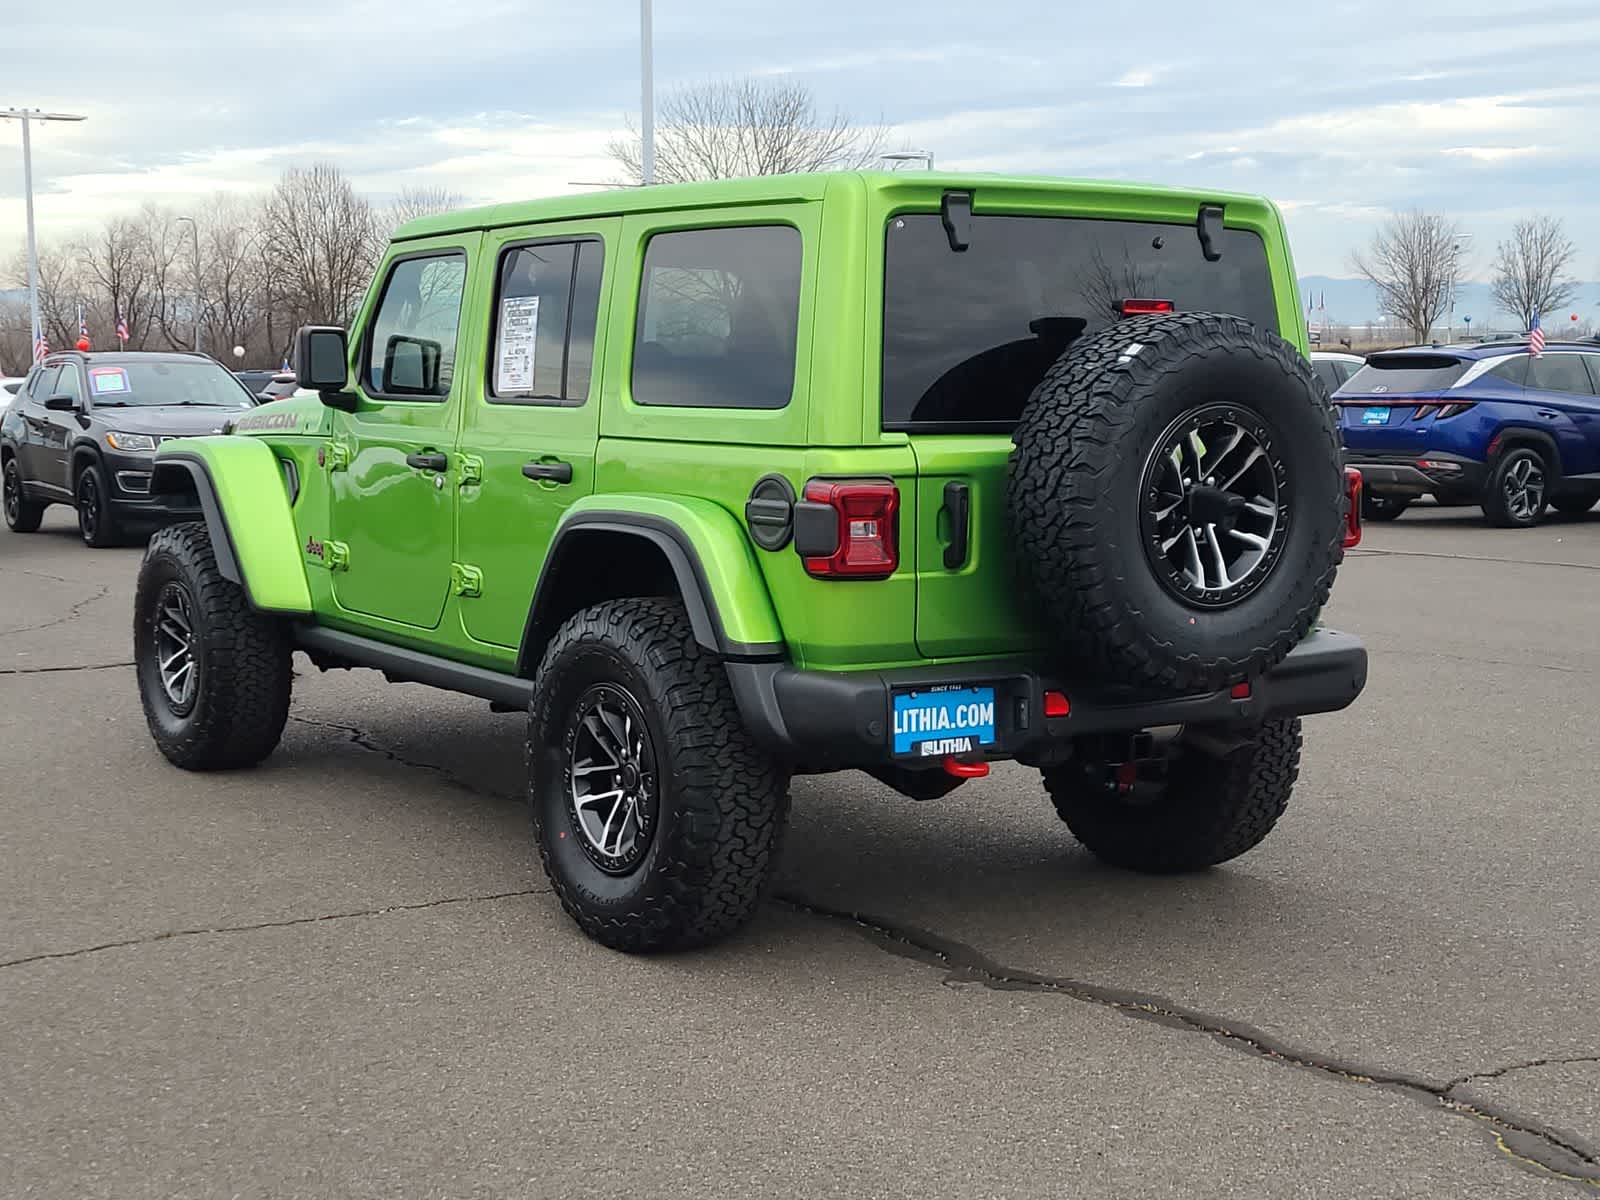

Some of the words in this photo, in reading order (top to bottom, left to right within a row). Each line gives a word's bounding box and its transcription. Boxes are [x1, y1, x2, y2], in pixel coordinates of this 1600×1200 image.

[238, 412, 298, 430] RUBICON
[306, 535, 324, 560] Jeep
[894, 702, 994, 735] LITHIA.COM
[933, 737, 972, 754] LITHIA
